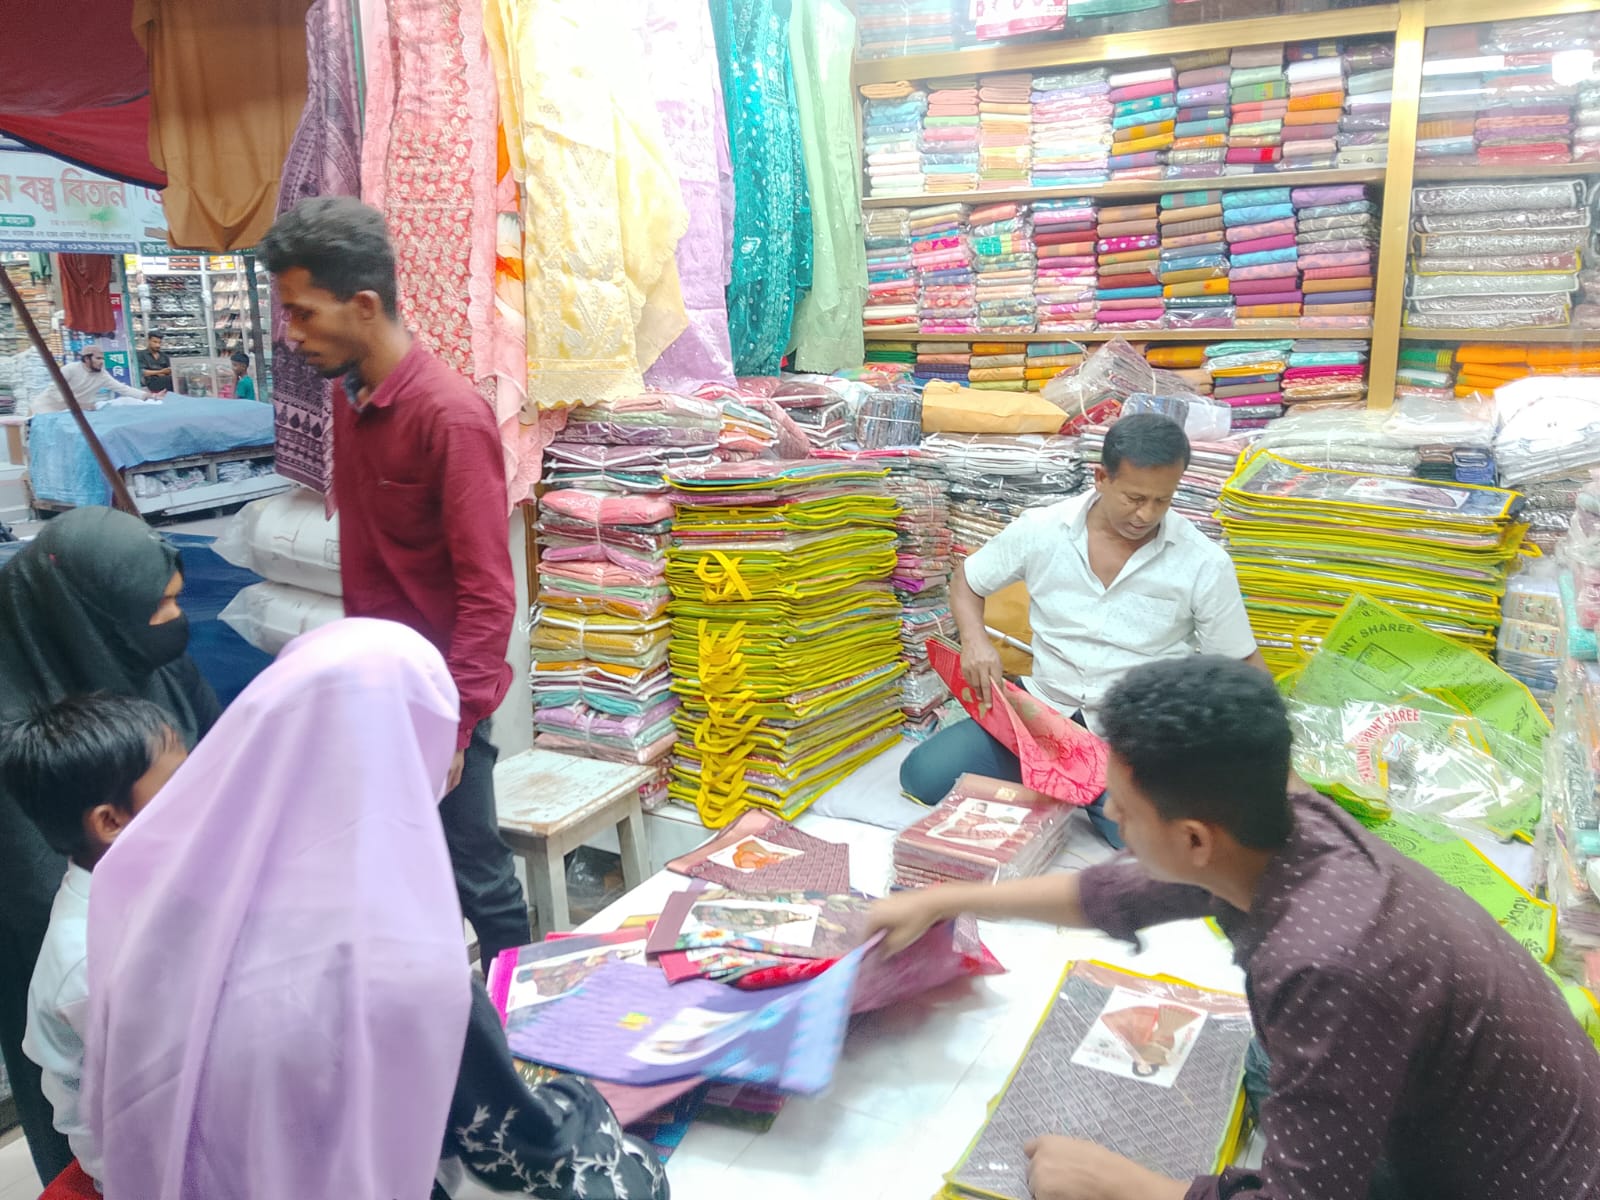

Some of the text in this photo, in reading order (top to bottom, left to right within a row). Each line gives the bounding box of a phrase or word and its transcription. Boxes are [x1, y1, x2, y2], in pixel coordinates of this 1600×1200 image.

[61, 168, 128, 208] বিতান
[1359, 623, 1415, 639] SHAREE
[1384, 708, 1419, 723] SAREE
